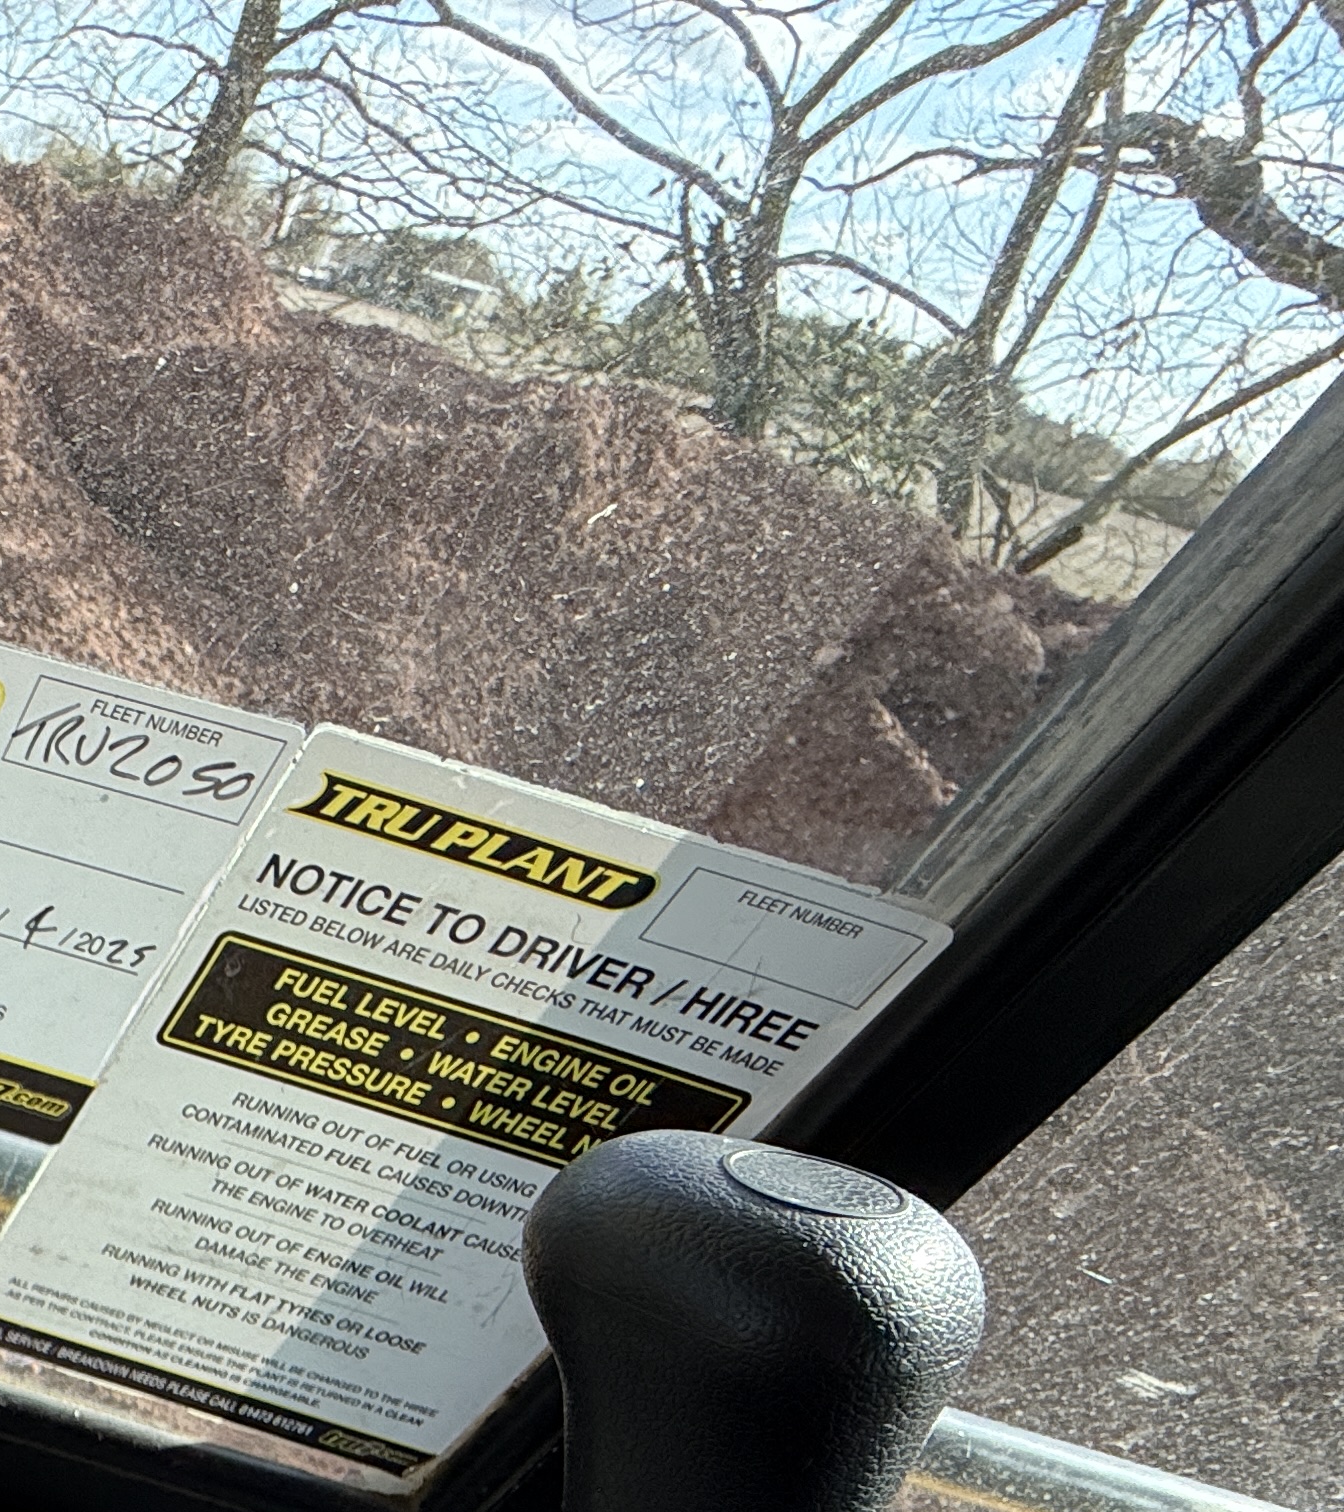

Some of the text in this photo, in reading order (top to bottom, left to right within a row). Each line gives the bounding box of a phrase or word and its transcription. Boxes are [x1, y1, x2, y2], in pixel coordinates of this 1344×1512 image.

[90, 698, 224, 748] FLEET NUMBER
[319, 783, 640, 902] TRU PLANT
[255, 853, 424, 927] NOTICE
[426, 902, 487, 946] TO
[488, 924, 656, 1000] DRIVER
[679, 985, 820, 1052] HIREE
[737, 889, 864, 940] FLEET NUMBER
[238, 893, 785, 1077] LISTED BELOW ARE DAILY CHECKS THAT MUST BE MADE
[273, 967, 656, 1107] FUEL LEVEL ENGINE OIL
[194, 1013, 273, 1060] TYRE
[270, 1038, 433, 1106] PRESSURE
[469, 1099, 568, 1151] WHEEL
[265, 1002, 622, 1131] GREASE WATER LEVEL
[148, 1133, 232, 1171] RUNNING
[235, 1159, 278, 1183] OUT
[275, 1173, 306, 1191] OF
[305, 1181, 373, 1214] WATER
[370, 1203, 464, 1244] COOLANT
[181, 1103, 324, 1157] CONTAMINATED
[324, 1148, 374, 1176] FUEL
[377, 1164, 453, 1199] CAUSES
[232, 1091, 538, 1198] RUNNING OUT OF FUEL OR USING
[150, 1197, 450, 1304] RUNNING OUT OF ENGINE OIL WILL
[194, 1235, 379, 1305] DAMAGE THE ENGINE
[211, 1177, 445, 1262] THE ENGINE TO OVERHEAT
[100, 1242, 428, 1355] RUNNING WITH FLAT TYRES OR LOOSE
[129, 1274, 371, 1361] WHEEL NUTS IS DANGEROUS
[165, 1379, 212, 1402] PLEASE
[211, 1391, 238, 1414] CALL
[364, 1387, 380, 1399] TO
